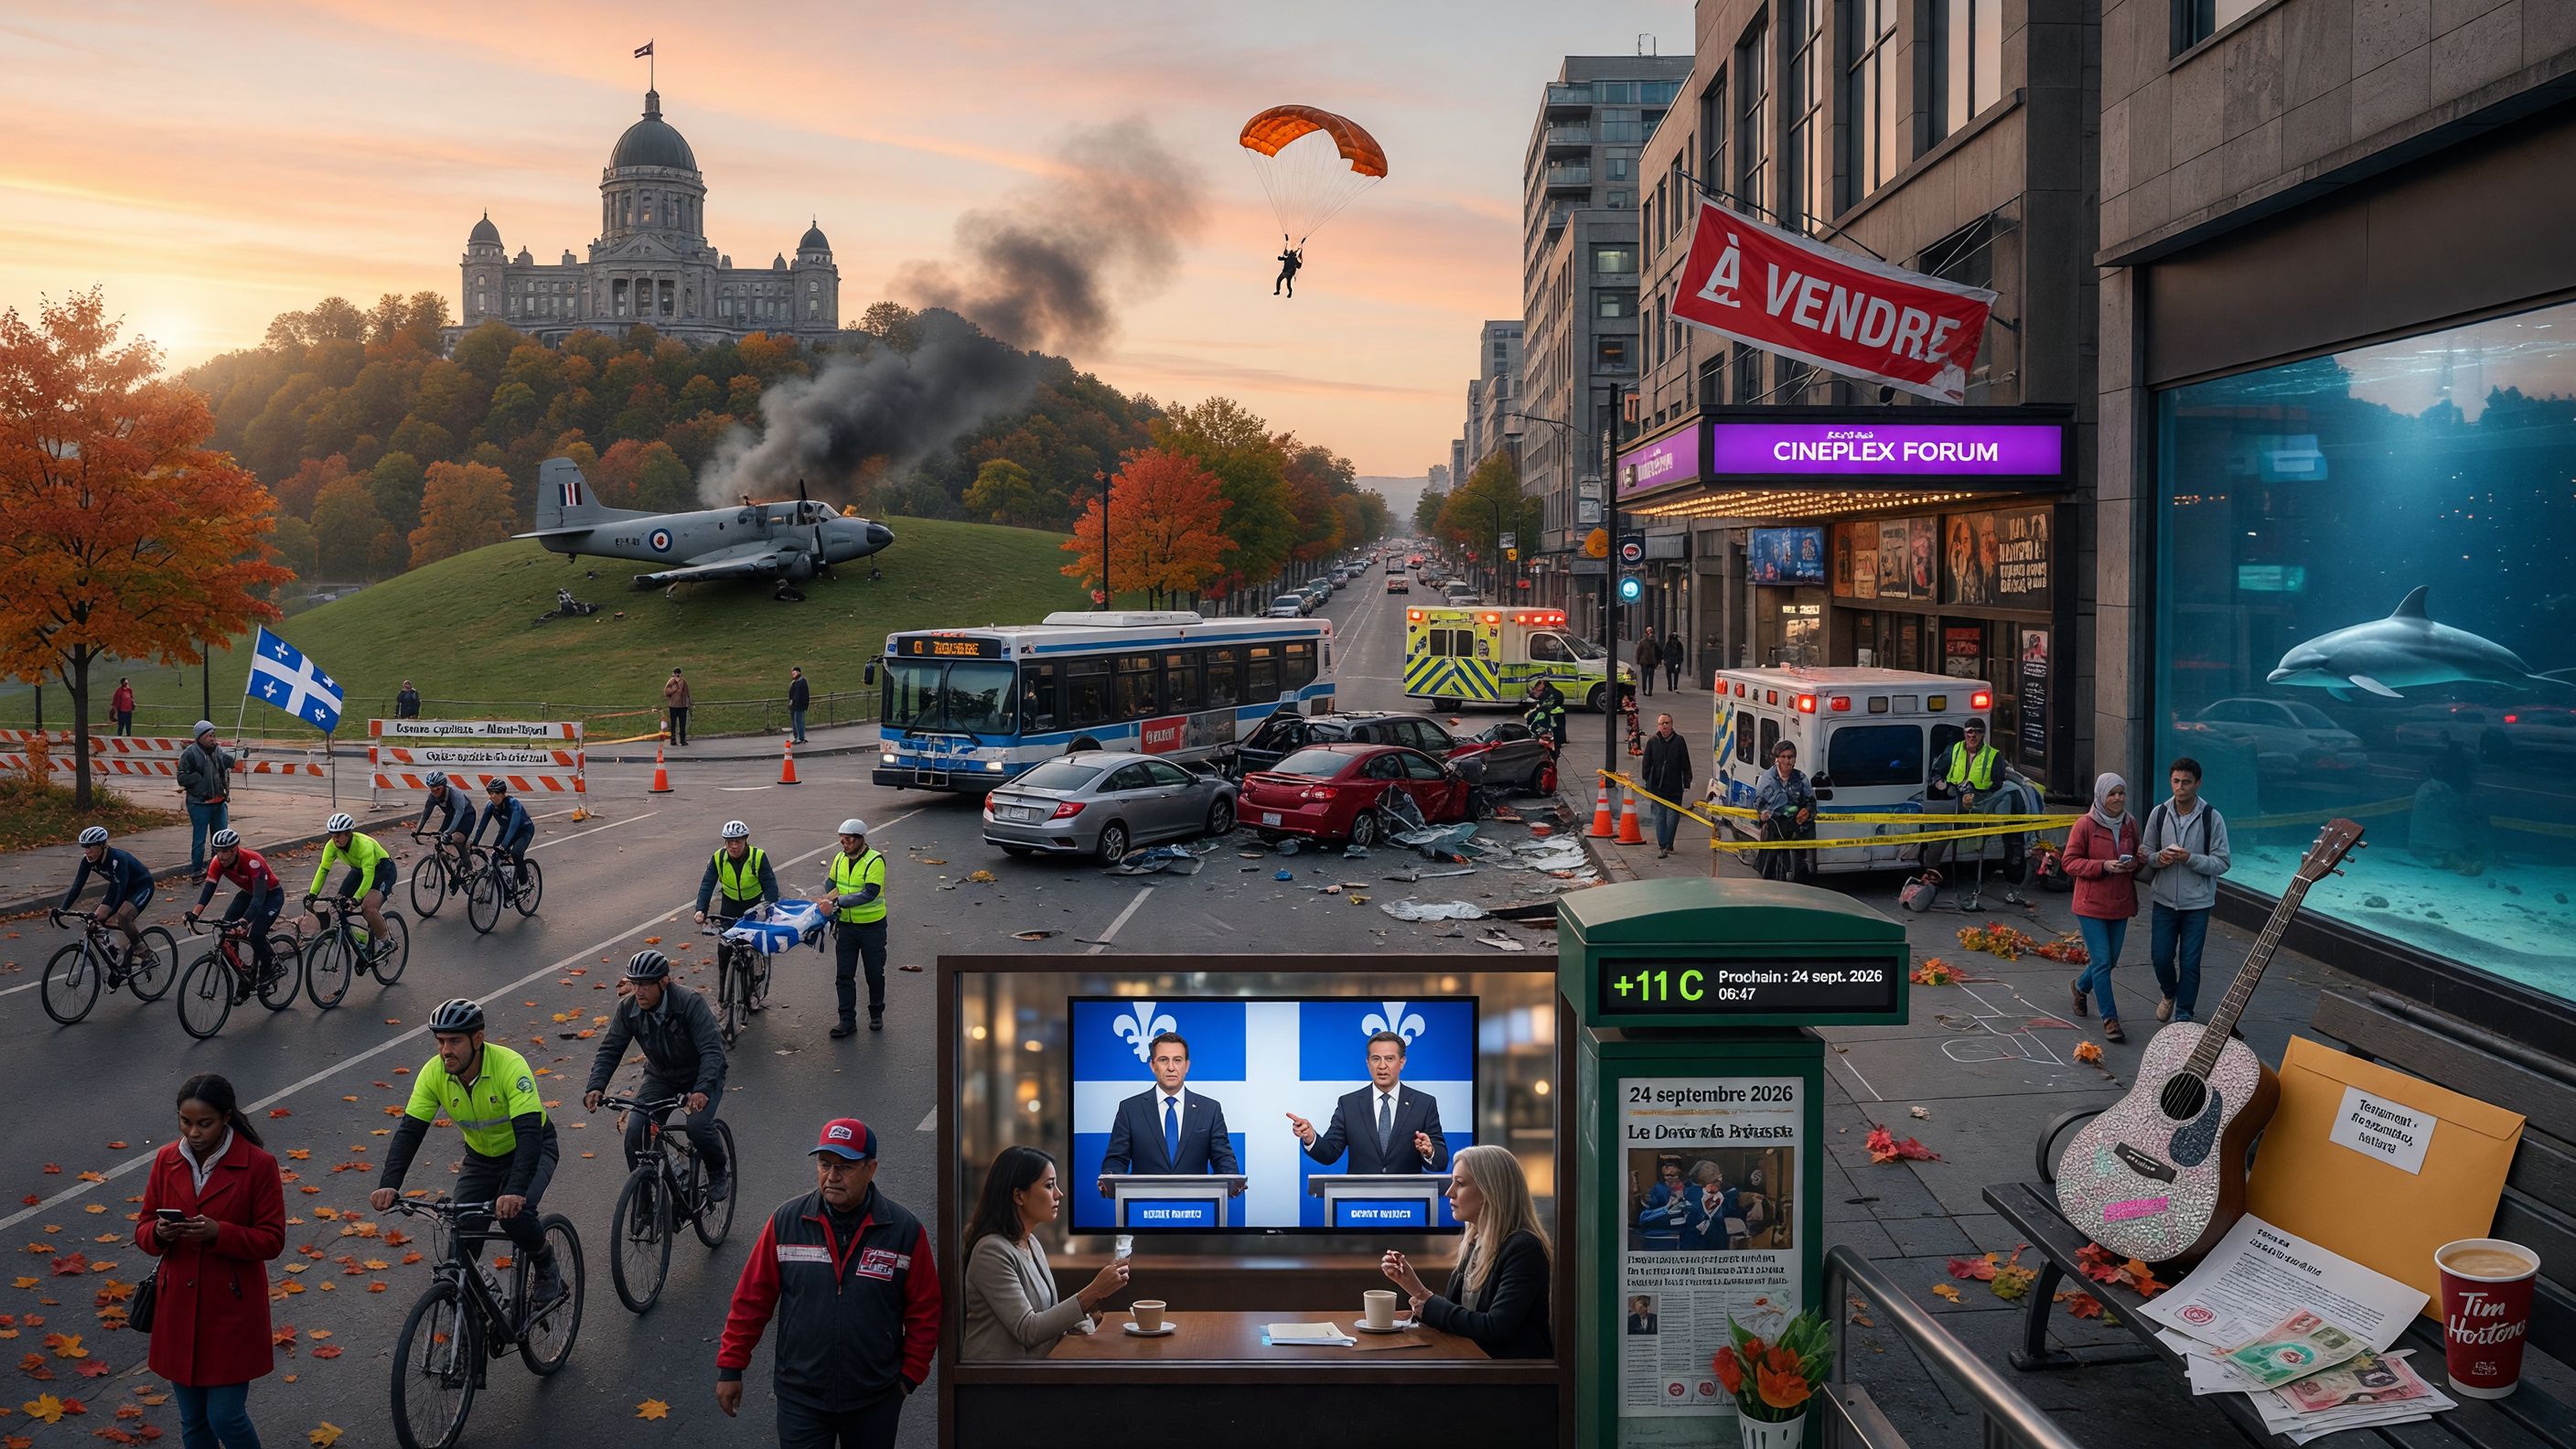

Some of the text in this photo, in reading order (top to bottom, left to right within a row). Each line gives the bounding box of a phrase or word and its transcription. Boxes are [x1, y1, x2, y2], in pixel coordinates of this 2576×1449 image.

[1697, 231, 1961, 364] À VENDRE
[1773, 441, 1999, 462] CINEPLEX FORUM
[1614, 969, 1704, 1002] +11 C
[1791, 970, 1809, 982] 24
[1812, 971, 1846, 984] sept.
[1850, 970, 1883, 982] 2026
[1718, 987, 1756, 1001] 06:47
[1629, 1085, 1793, 1107] 24 septembre 2026
[1627, 1124, 1650, 1140] Le
